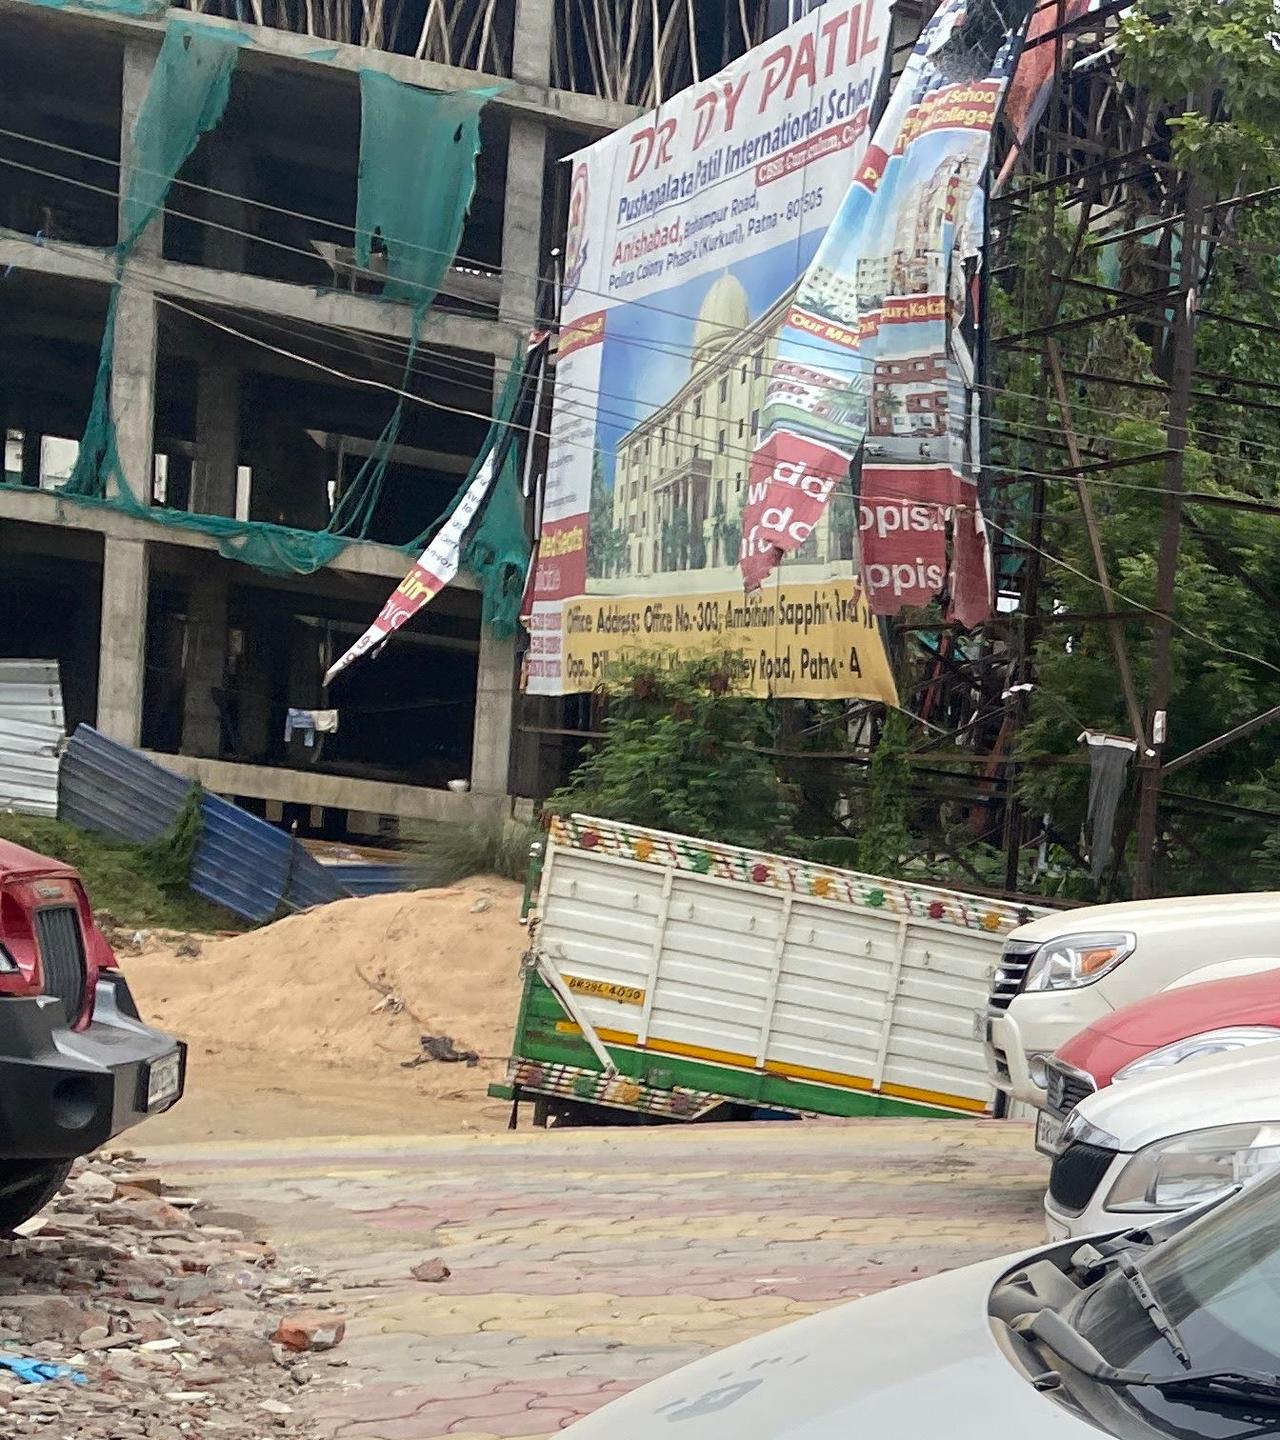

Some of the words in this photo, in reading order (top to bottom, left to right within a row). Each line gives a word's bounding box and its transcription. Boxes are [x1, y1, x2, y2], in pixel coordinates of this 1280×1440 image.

[627, 118, 677, 183] DR
[692, 71, 750, 151] DY
[758, 0, 880, 115] PATIL
[725, 95, 824, 171] International
[747, 212, 778, 237] Patna
[791, 313, 826, 333] Our
[567, 604, 592, 634] Office
[644, 602, 672, 633] Office
[759, 645, 795, 683] Road,
[850, 647, 862, 679] A
